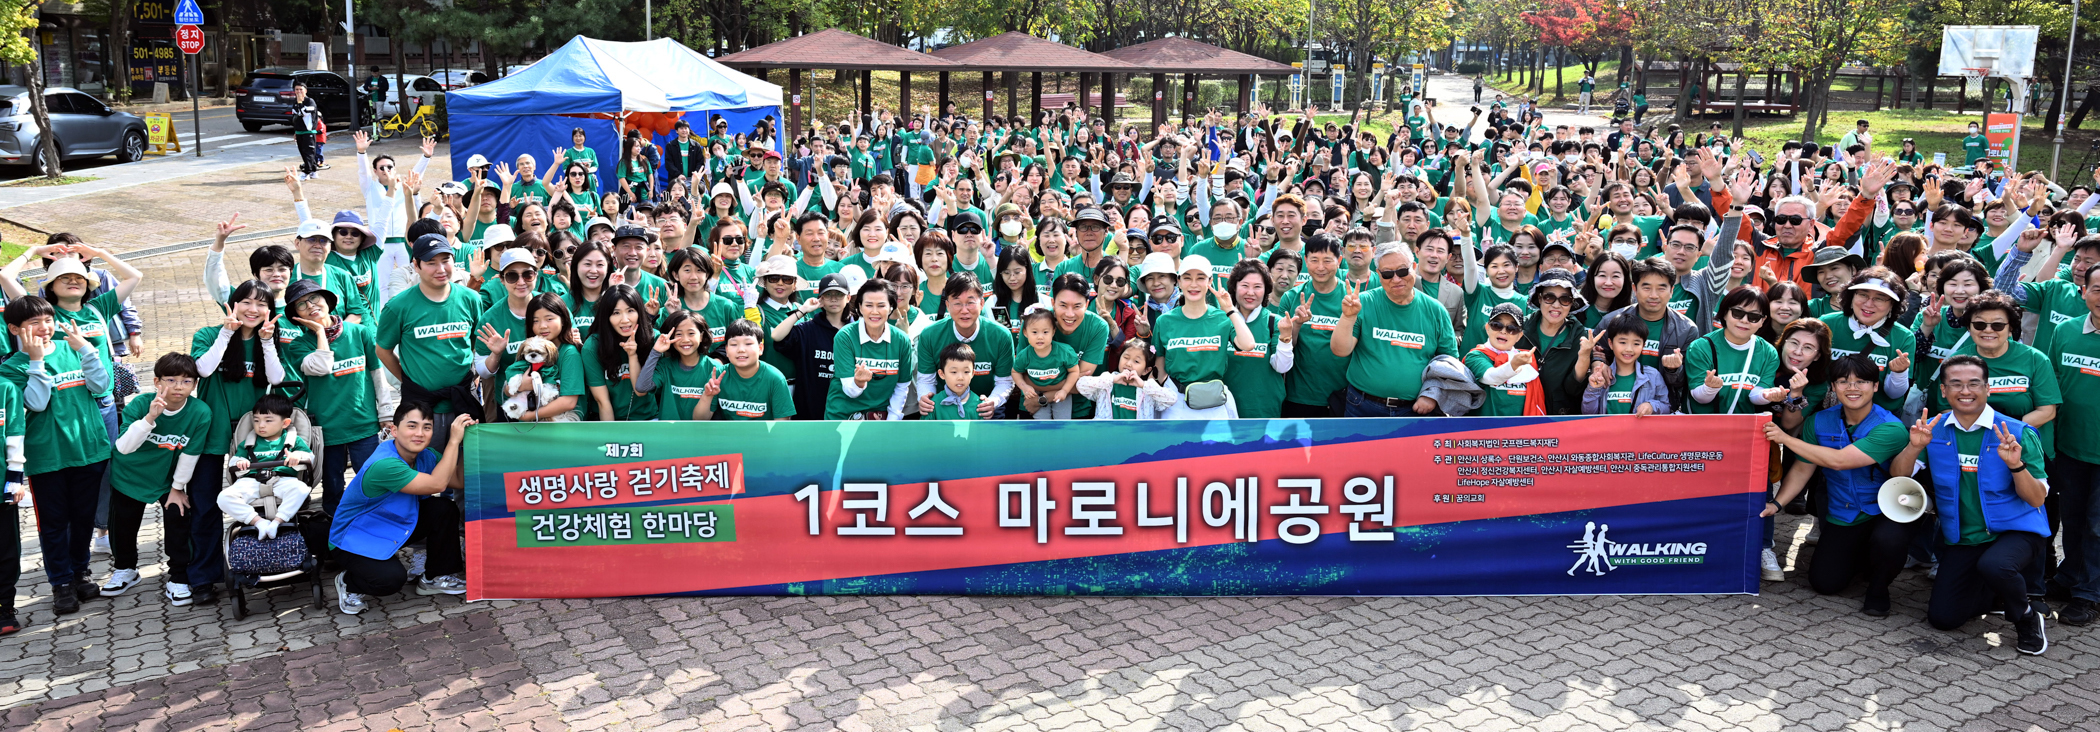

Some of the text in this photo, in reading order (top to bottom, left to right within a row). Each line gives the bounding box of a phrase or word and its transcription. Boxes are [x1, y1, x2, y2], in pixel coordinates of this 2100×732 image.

[180, 29, 199, 40] 정지
[181, 41, 200, 49] STOP
[133, 47, 175, 59] 501-4985
[417, 323, 469, 336] WALKING
[1375, 329, 1424, 343] WALKING
[1168, 337, 1220, 346] WALKING
[331, 357, 366, 371] LKING
[1989, 377, 2028, 386] LKING
[720, 400, 767, 412] WALKING
[1457, 439, 1500, 449] 사회복지법인
[1502, 438, 1559, 448] 굿프렌드복지재단
[605, 443, 643, 458] 제7회
[1457, 455, 1479, 464] 안산시
[1481, 454, 1502, 464] 상록수
[1547, 453, 1569, 463] 안산시
[1638, 452, 1679, 460] LifeCulture
[1680, 451, 1723, 461] 생명문화운동
[1457, 466, 1479, 475] 안산시
[1541, 465, 1562, 474] 안산시
[1610, 464, 1632, 473] 안산시
[1633, 462, 1705, 472] 중독관리통합지원센터
[518, 461, 730, 505] 생명사랑 걷기축제
[1457, 478, 1534, 488] LifeHope 자살예방센터
[1456, 494, 1485, 503] 꿈의교회
[794, 475, 1395, 545] 1코스 마로니에공원
[532, 511, 718, 542] 건강체험 한마당
[1609, 542, 1708, 556] WALKING
